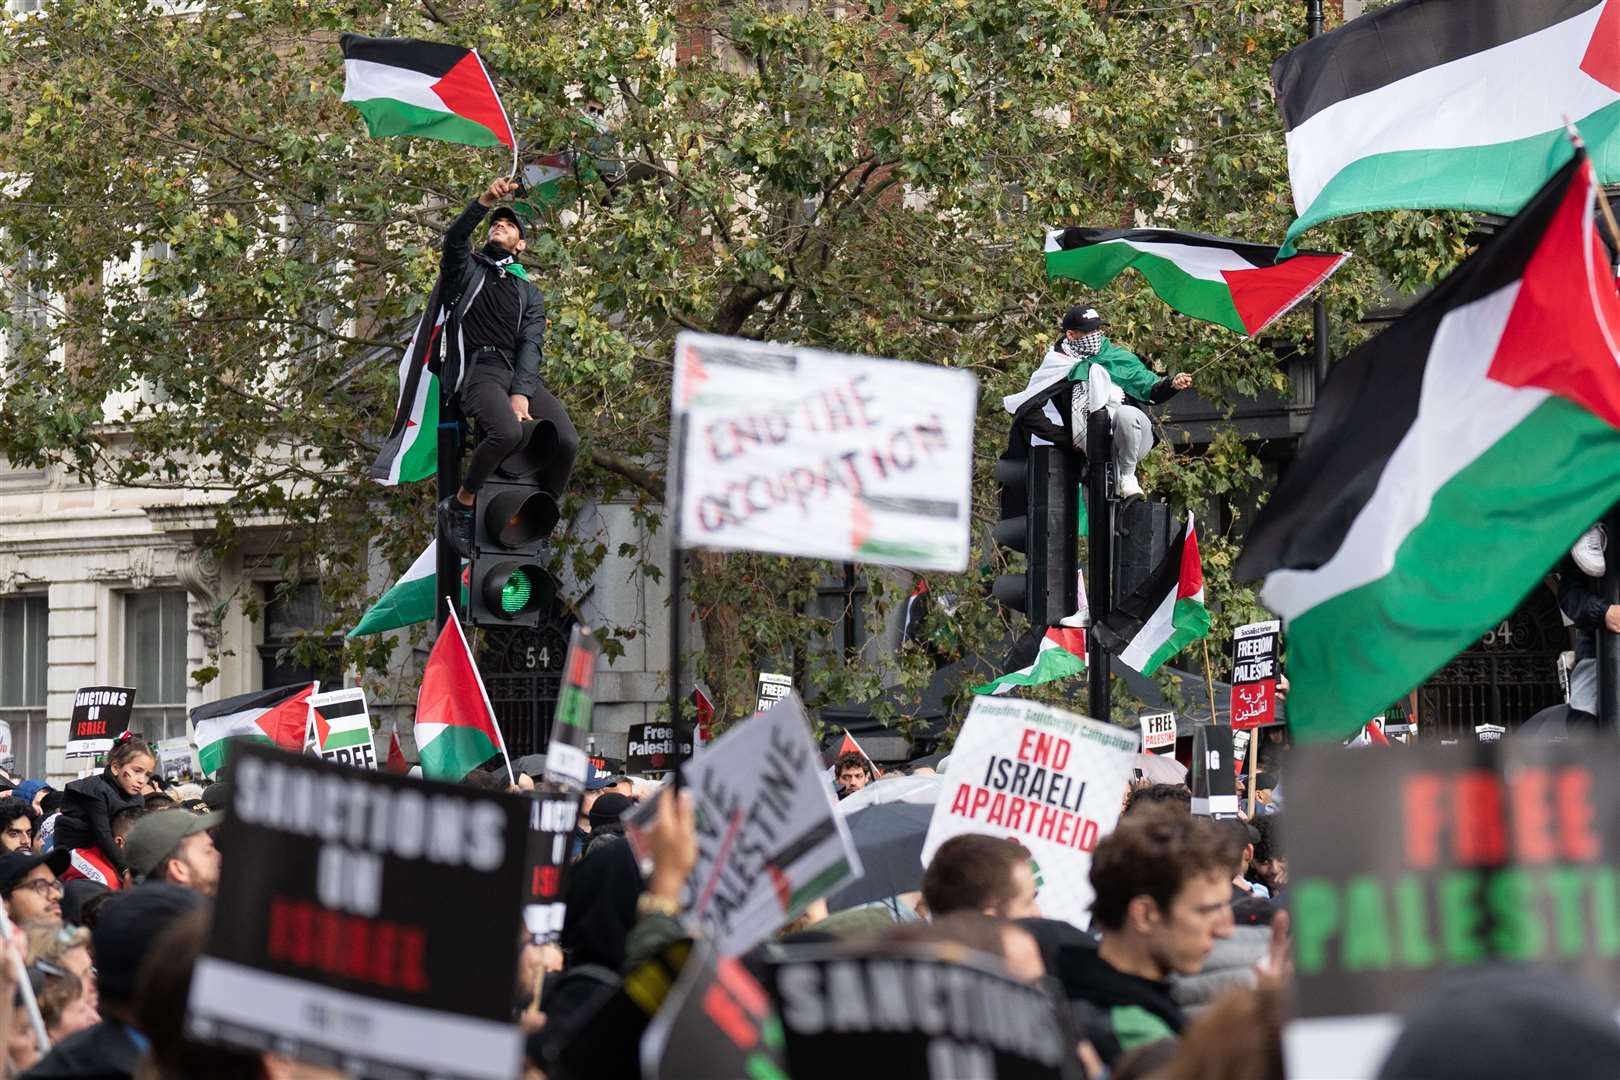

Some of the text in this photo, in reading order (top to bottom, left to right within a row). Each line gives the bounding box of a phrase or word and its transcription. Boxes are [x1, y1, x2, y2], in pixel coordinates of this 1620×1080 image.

[704, 373, 880, 462] END THE
[697, 414, 947, 532] OCCUPATION
[526, 647, 550, 668] 54
[76, 691, 127, 707] SANCTIONS
[87, 706, 101, 721] ON
[77, 720, 107, 737] ISRAEL
[643, 725, 673, 740] Free
[1145, 731, 1175, 746] PALESTINE
[1149, 714, 1173, 734] FREE
[1017, 728, 1072, 773] END
[984, 755, 1086, 813] ISRAELI
[950, 783, 1100, 854] APARTHEID
[1404, 766, 1599, 869] FREE
[1294, 864, 1620, 974] PALESTI
